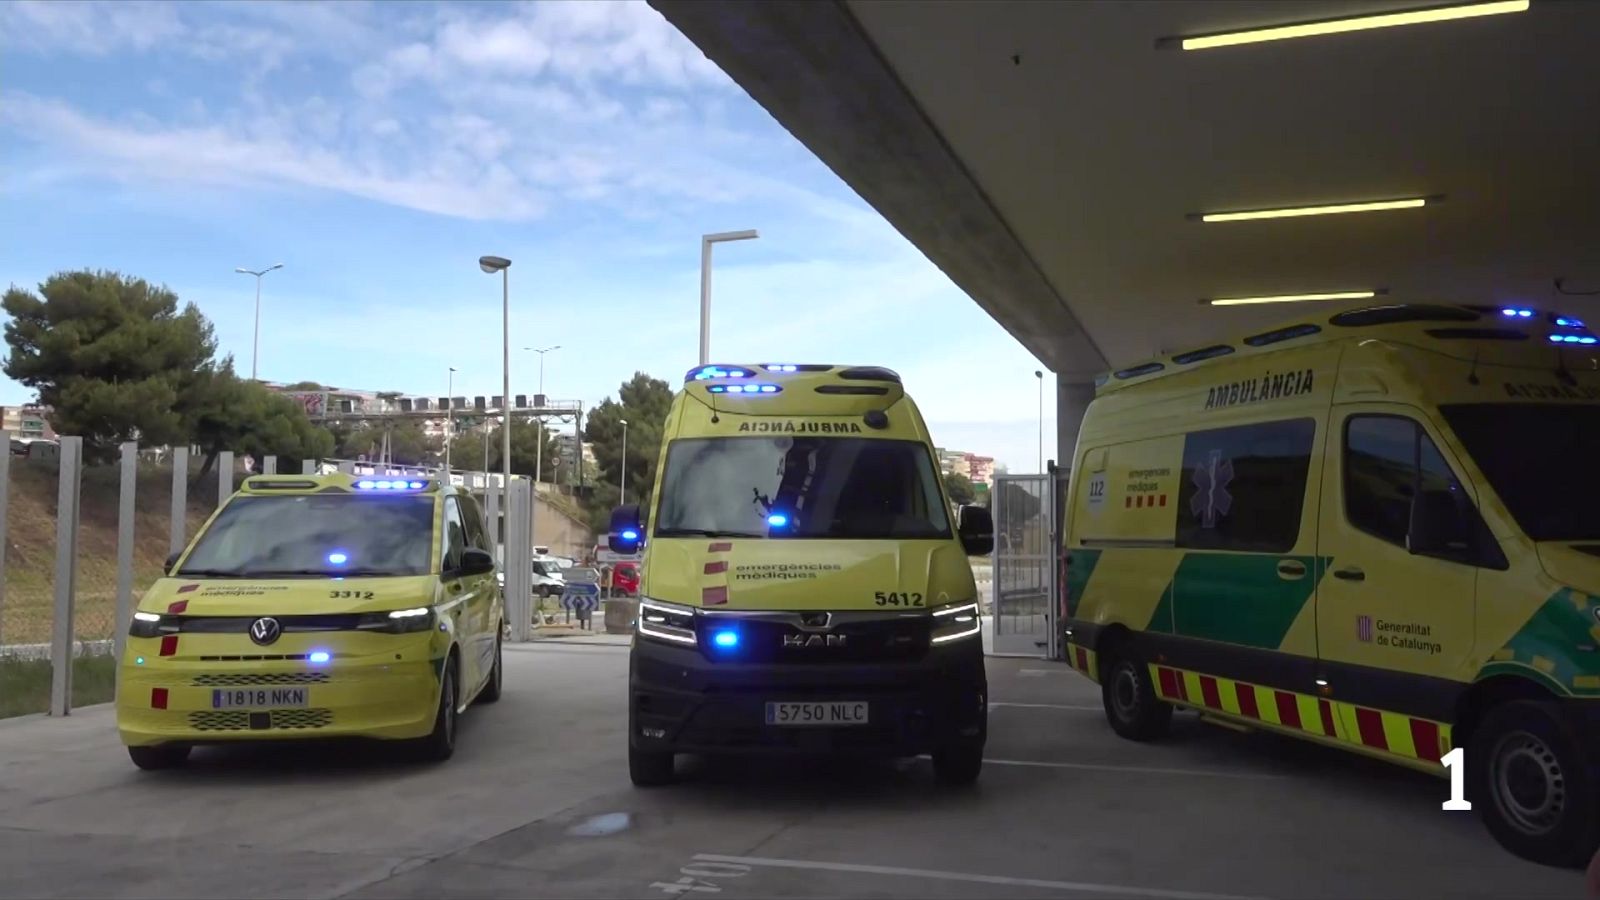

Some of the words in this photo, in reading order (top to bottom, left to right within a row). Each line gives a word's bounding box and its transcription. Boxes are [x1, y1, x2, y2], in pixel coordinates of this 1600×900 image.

[1090, 481, 1104, 496] 112
[329, 590, 374, 600] 3312
[875, 592, 924, 607] 5412
[1376, 620, 1431, 636] Generalitat
[1377, 636, 1388, 646] de
[1391, 636, 1442, 655] Catalunya
[227, 690, 266, 705] 1818
[271, 689, 303, 704] NKN
[780, 704, 824, 720] 5750
[831, 704, 864, 720] NLC
